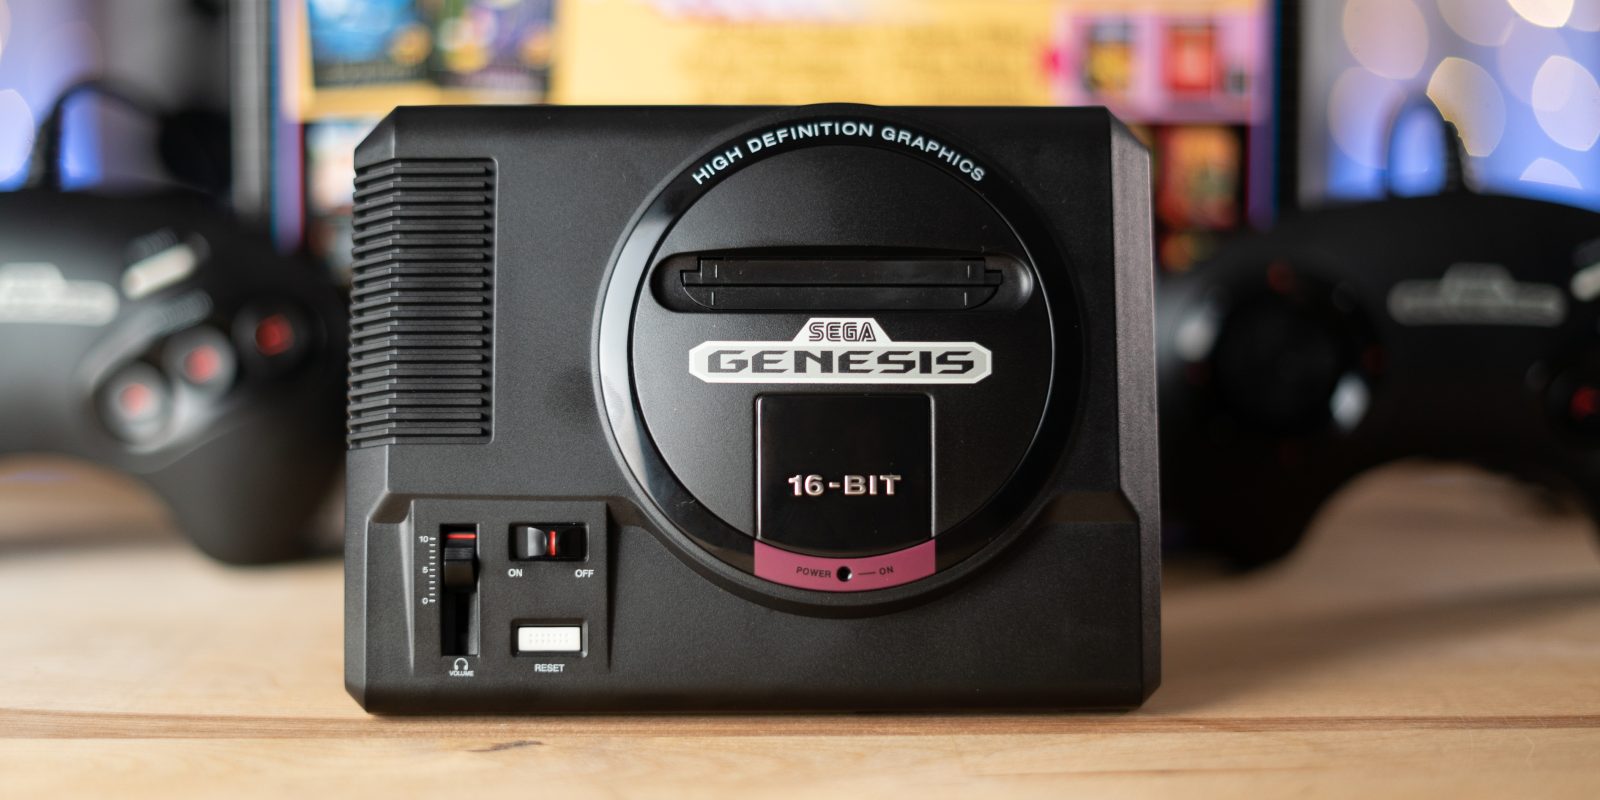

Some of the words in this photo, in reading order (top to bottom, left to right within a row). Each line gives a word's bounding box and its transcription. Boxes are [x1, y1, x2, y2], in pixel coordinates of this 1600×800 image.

[692, 146, 743, 185] HIGH
[746, 122, 874, 154] DEFINITION
[881, 124, 985, 182] GRAPHICS
[808, 321, 876, 342] SEGA
[707, 350, 975, 374] GENESIS
[788, 474, 902, 496] 16-BIT
[419, 535, 429, 543] 10
[422, 566, 429, 574] 5
[508, 568, 523, 578] ON
[575, 568, 595, 578] OFF
[796, 566, 832, 578] POWER
[879, 566, 894, 576] ON
[422, 597, 429, 605] 0
[534, 663, 565, 672] RESET
[449, 669, 474, 677] VOLUME
